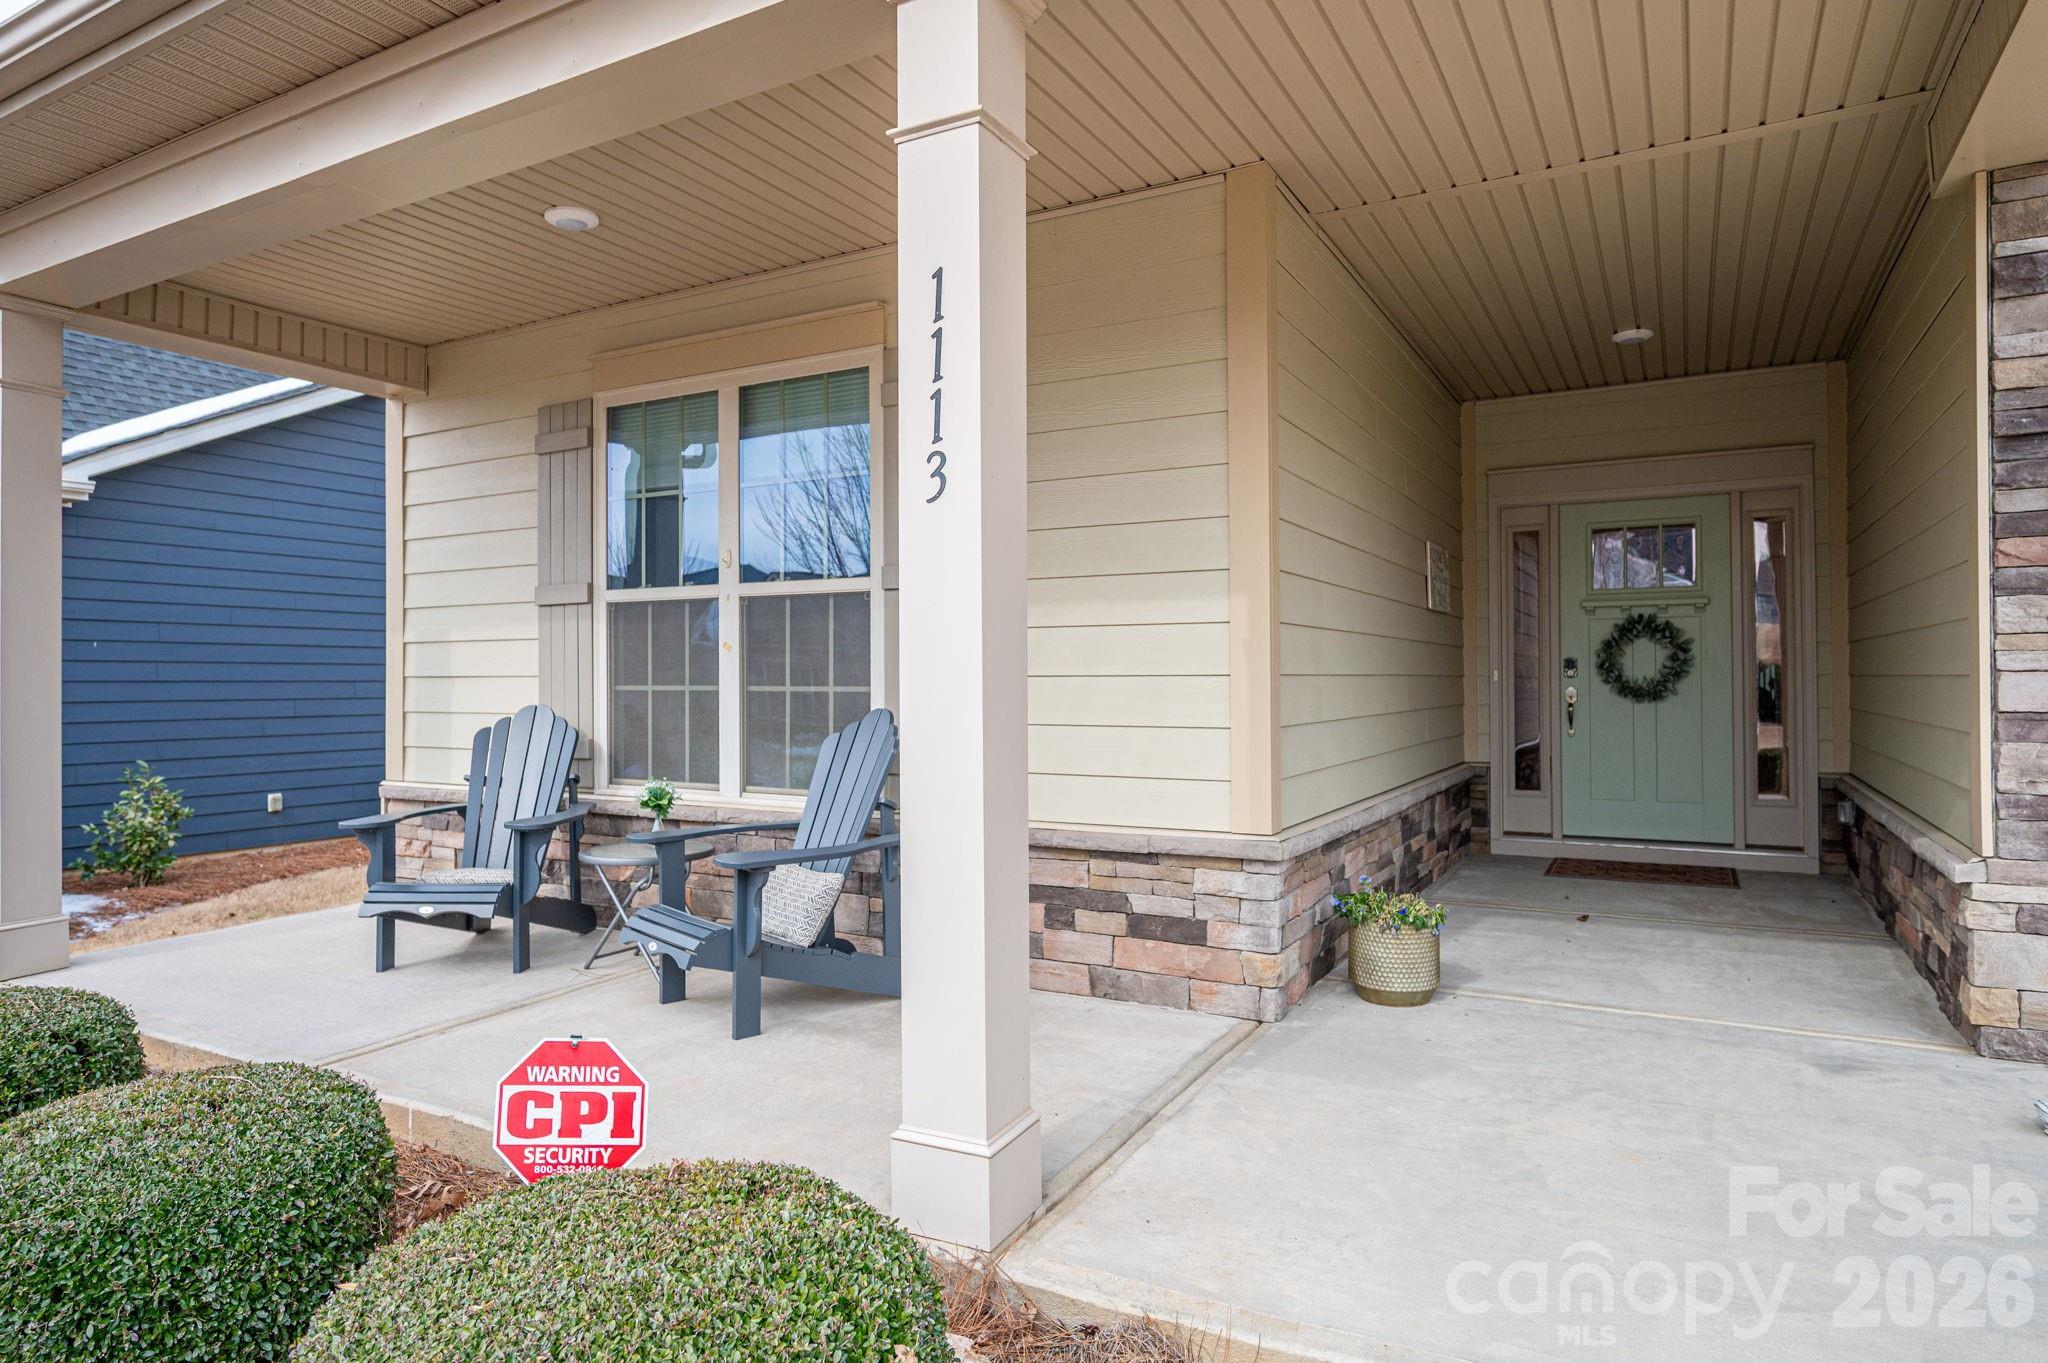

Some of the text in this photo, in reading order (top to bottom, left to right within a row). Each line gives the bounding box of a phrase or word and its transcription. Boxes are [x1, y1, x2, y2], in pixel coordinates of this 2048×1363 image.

[926, 266, 947, 504] 1113
[527, 1066, 620, 1082] WARNING
[506, 1090, 637, 1139] CPI
[524, 1147, 614, 1164] SECURITY
